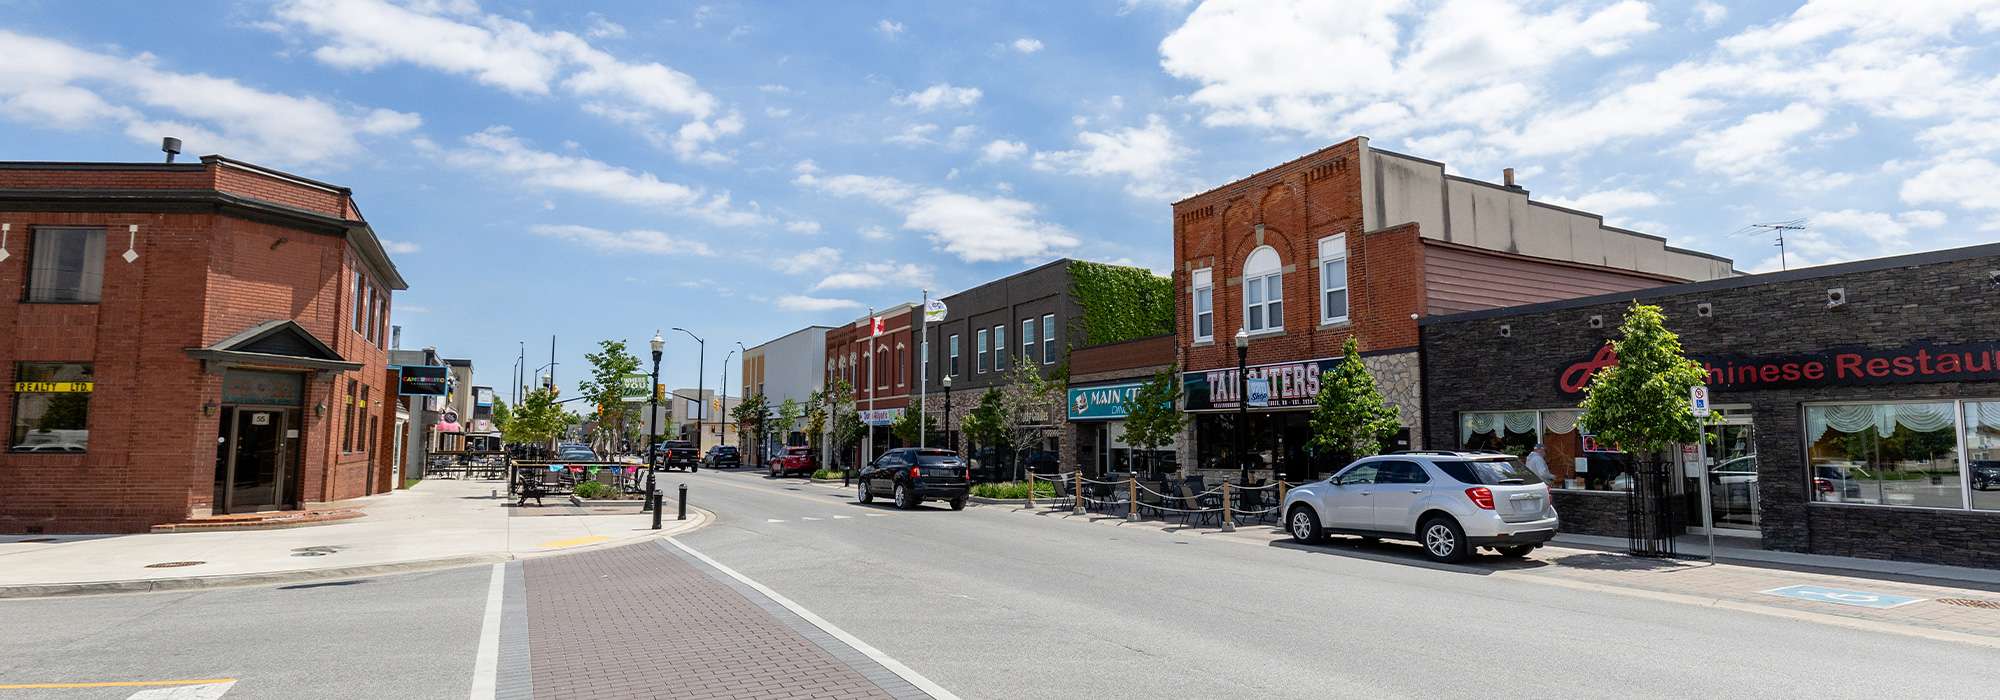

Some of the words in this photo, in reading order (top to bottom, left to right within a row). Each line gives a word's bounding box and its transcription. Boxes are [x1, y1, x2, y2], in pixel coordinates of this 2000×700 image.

[1692, 359, 1824, 385] hinese
[19, 382, 56, 392] REALTY
[70, 382, 89, 392] LTD.
[1090, 389, 1121, 405] MAIN
[1251, 392, 1269, 401] Shop
